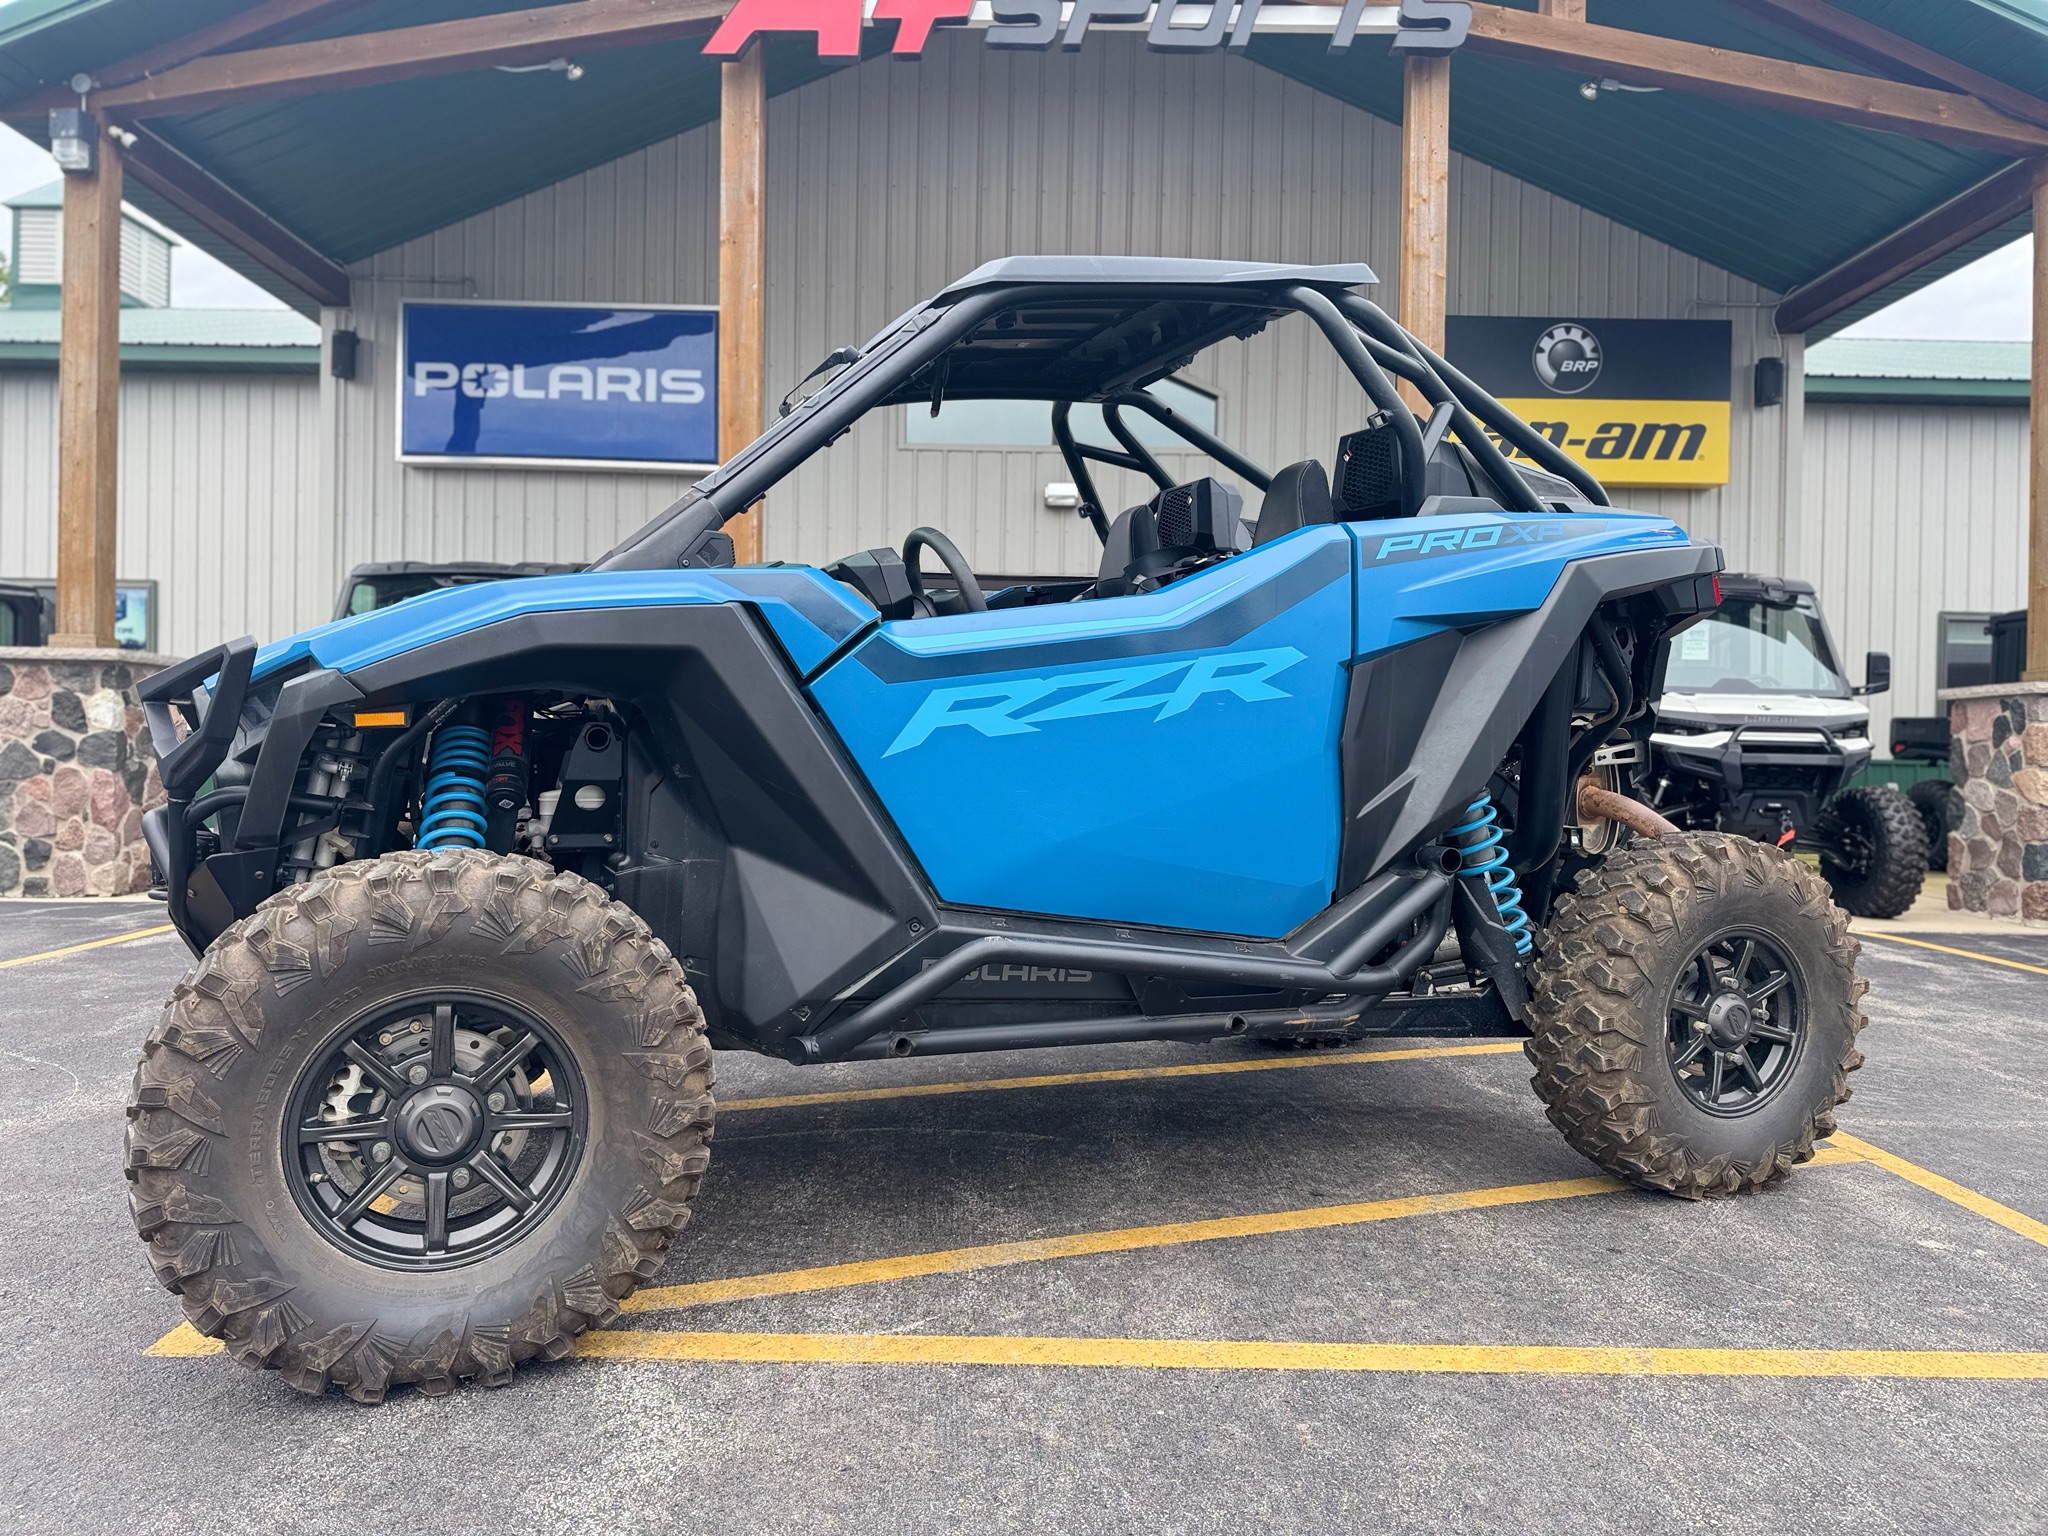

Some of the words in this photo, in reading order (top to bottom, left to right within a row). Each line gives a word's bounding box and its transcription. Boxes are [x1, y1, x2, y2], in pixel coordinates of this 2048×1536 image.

[414, 362, 706, 404] POLARIS
[1560, 360, 1599, 373] BRP
[1446, 421, 1707, 461] n-am
[1376, 525, 1503, 560] PRO
[1503, 524, 1564, 544] XP
[881, 646, 1308, 759] RZR
[921, 957, 1094, 983] LARIS
